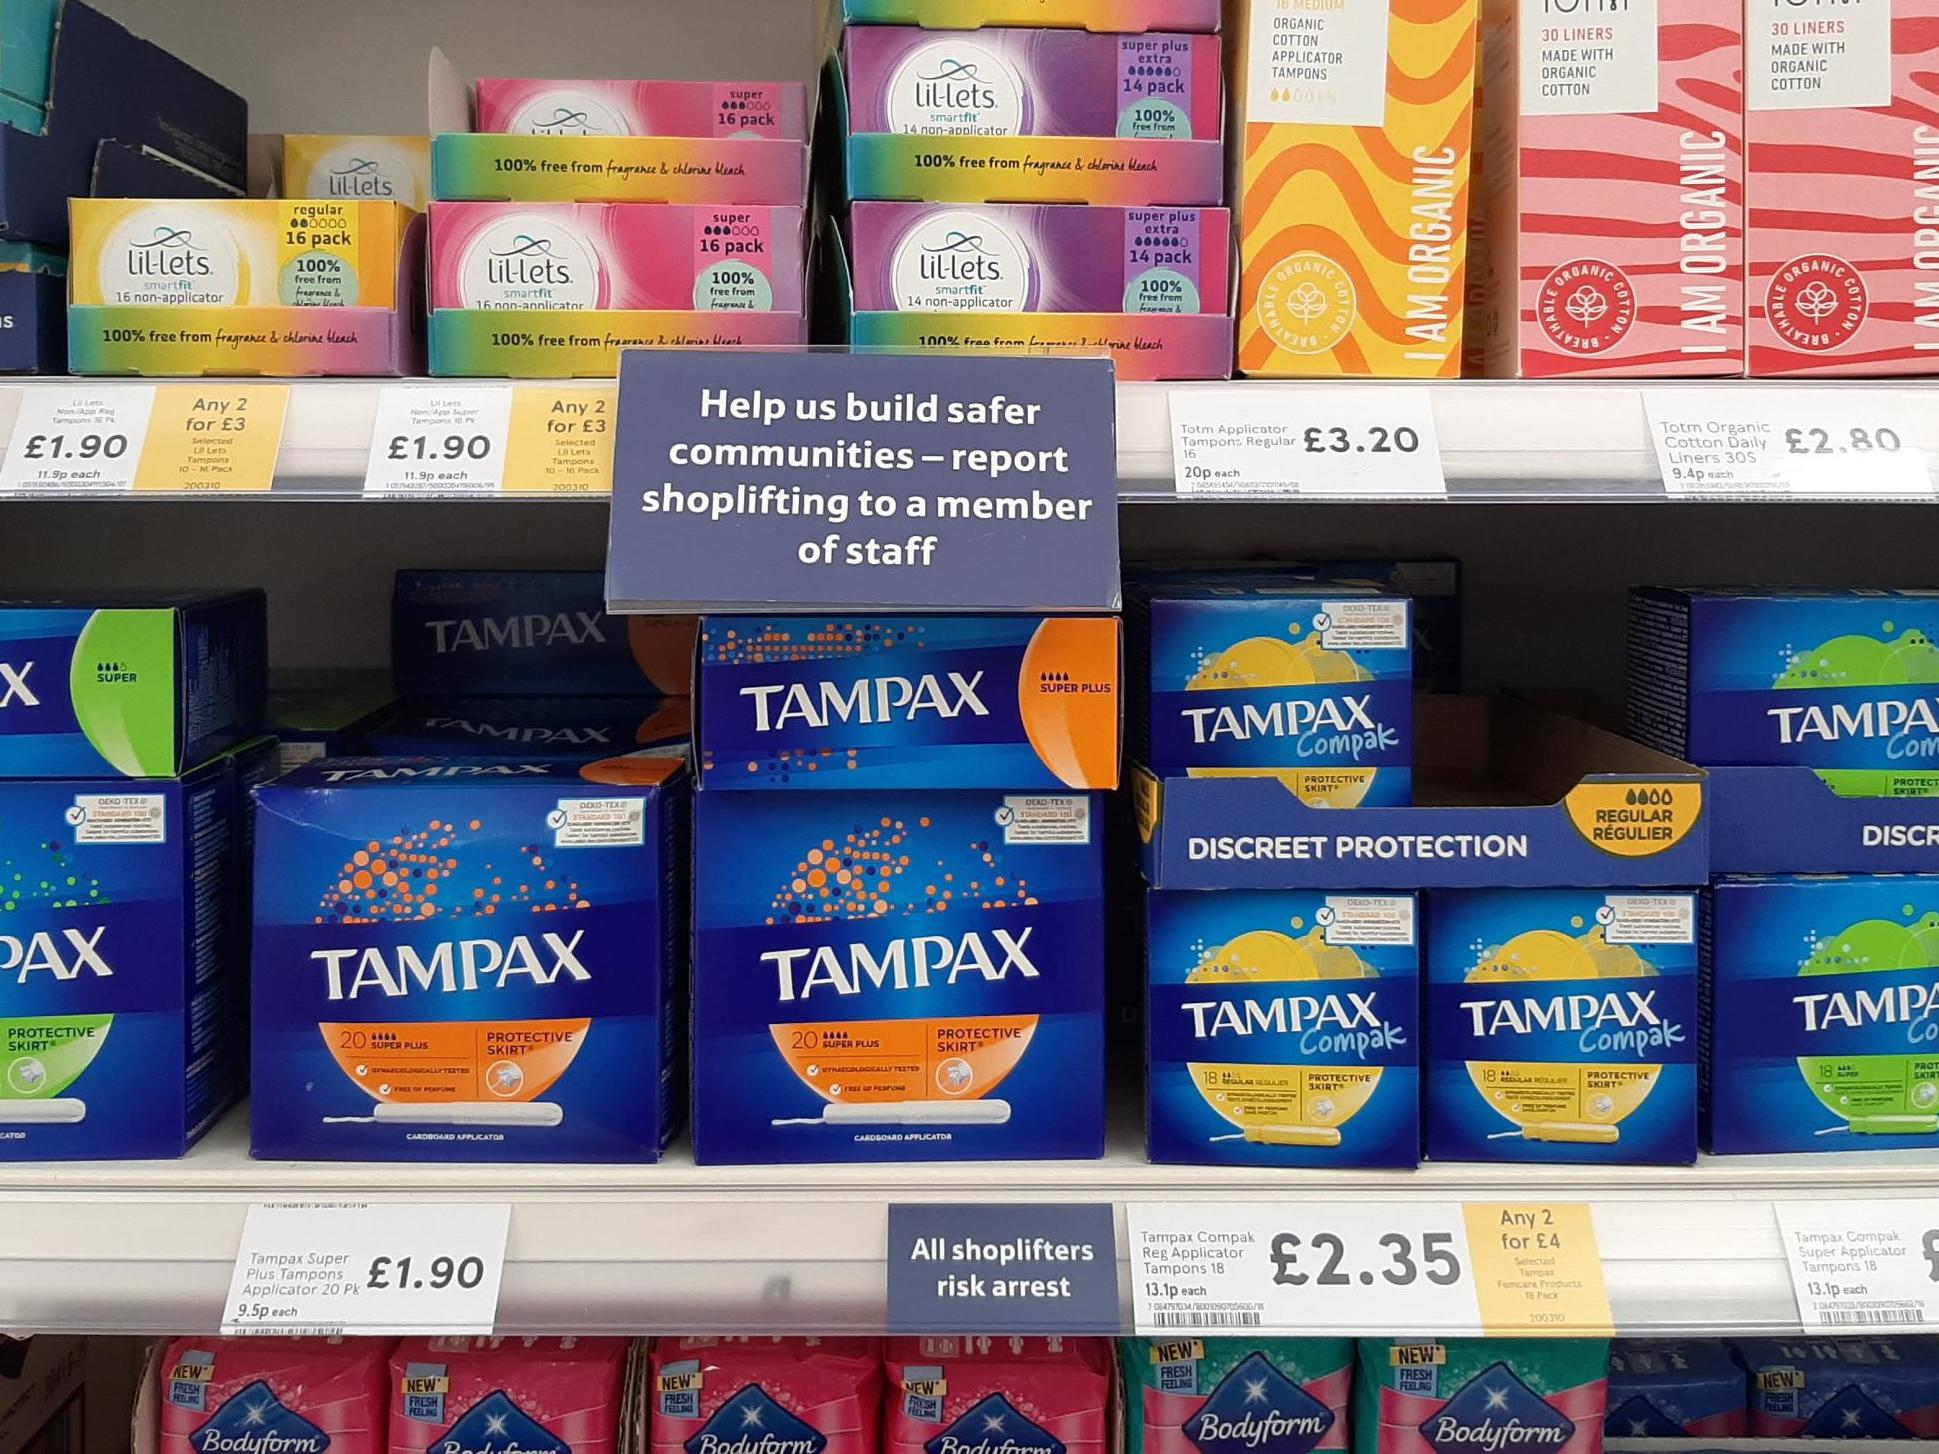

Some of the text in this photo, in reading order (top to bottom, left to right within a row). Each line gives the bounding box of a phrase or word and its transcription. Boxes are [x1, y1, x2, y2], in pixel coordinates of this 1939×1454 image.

[1273, 17, 1325, 31] ORGANIC
[1272, 34, 1319, 47] COTTON
[1541, 27, 1613, 42] 30 LINERS
[1271, 50, 1343, 65] APPLICATOR
[1541, 48, 1614, 62] MADE WITH
[1271, 66, 1328, 81] TAMPONS
[1541, 66, 1597, 80] ORGANIC
[1541, 83, 1590, 97] COTTON
[930, 111, 979, 123] smartfit
[494, 159, 745, 180] 100% free from fragrance & chlorine bleach
[1679, 130, 1728, 275] ORGANIC
[293, 204, 344, 219] regular
[1128, 210, 1196, 226] super plus
[1407, 145, 1457, 286] ORGANIC
[712, 213, 751, 227] super
[1145, 224, 1179, 235] extra
[286, 231, 352, 249] 16 pack
[700, 239, 764, 256] 16 pack
[1129, 250, 1192, 267] 14 pack
[116, 291, 224, 305] 16 non-applicator
[1404, 293, 1449, 343] AM
[1680, 285, 1728, 335] AM
[192, 397, 248, 412] Any 2
[551, 400, 606, 416] Any 2
[700, 388, 1041, 426] Help us build safer
[186, 417, 246, 431] for £3
[547, 419, 607, 433] for £3
[1181, 424, 1288, 435] Totm Applicator
[1660, 421, 1771, 436] Totm Organic
[24, 434, 128, 459] £1.90
[388, 435, 491, 460] £1.90
[1183, 436, 1296, 447] Tampons Regular
[1303, 427, 1419, 453] £3.20
[1665, 436, 1767, 451] Cotton Daily
[1784, 427, 1901, 454] £2.80
[669, 440, 914, 470] communities
[952, 446, 1069, 477] report
[1184, 449, 1197, 459] 16
[1669, 452, 1757, 464] Liners 30S
[71, 469, 101, 479] each
[1184, 466, 1240, 480] 20p each
[1672, 467, 1734, 481] 9.4p each
[642, 483, 1093, 523] shoplifting to a member
[798, 534, 938, 566] of staff
[424, 611, 606, 654] TAMPAX
[97, 673, 137, 683] SUPER
[1040, 682, 1112, 693] SUPER PLUS
[739, 670, 989, 732] TAMPAX
[1181, 694, 1376, 743] TAMPAX
[424, 717, 610, 743] TAMPAX
[1296, 722, 1399, 760] Compak
[321, 763, 552, 782] TAMPAX
[1304, 775, 1365, 785] PROTECTIVE
[1595, 809, 1673, 824] REGULAR
[1593, 823, 1673, 841] RÉGULIER
[1188, 834, 1528, 860] DISCREET PROTECTION
[310, 930, 592, 1000] TAMPAX
[760, 927, 1040, 1001] TAMPAX
[1181, 991, 1382, 1038] TAMPAX
[1459, 990, 1661, 1037] TAMPAX
[8, 1027, 95, 1040] PROTECTIVE
[340, 1030, 429, 1050] 20 SUPER PLUS
[486, 1031, 573, 1044] PROTECTIVE
[937, 1028, 1022, 1040] PROTECTIVE
[1299, 1020, 1408, 1060] Compak
[1578, 1018, 1686, 1058] Compak
[1500, 1209, 1554, 1226] Any 2
[1140, 1231, 1255, 1245] Tampax Compak
[1502, 1232, 1561, 1249] for £4
[1794, 1230, 1901, 1245] Tampax Compak
[250, 1252, 350, 1266] Tampax Super
[911, 1238, 1094, 1265] All shoplifters
[1143, 1246, 1244, 1260] Reg Applicator
[1269, 1232, 1461, 1286] £2.35
[1799, 1246, 1907, 1260] Super Applicator
[246, 1268, 343, 1282] Plus Tampons
[366, 1256, 484, 1289] £1.90
[1144, 1262, 1225, 1276] Tampons 18
[242, 1283, 361, 1298] Applicator 20 Pk
[937, 1275, 1071, 1298] risk arrest
[1146, 1283, 1207, 1299] 13.1p each
[238, 1303, 298, 1320] 9.5p each
[1161, 1366, 1192, 1378] FRESH
[1161, 1379, 1192, 1389] FEELING
[1198, 1409, 1325, 1448] Bodyform
[1435, 1414, 1565, 1448] Bodyform
[202, 1429, 320, 1454] Bodyform
